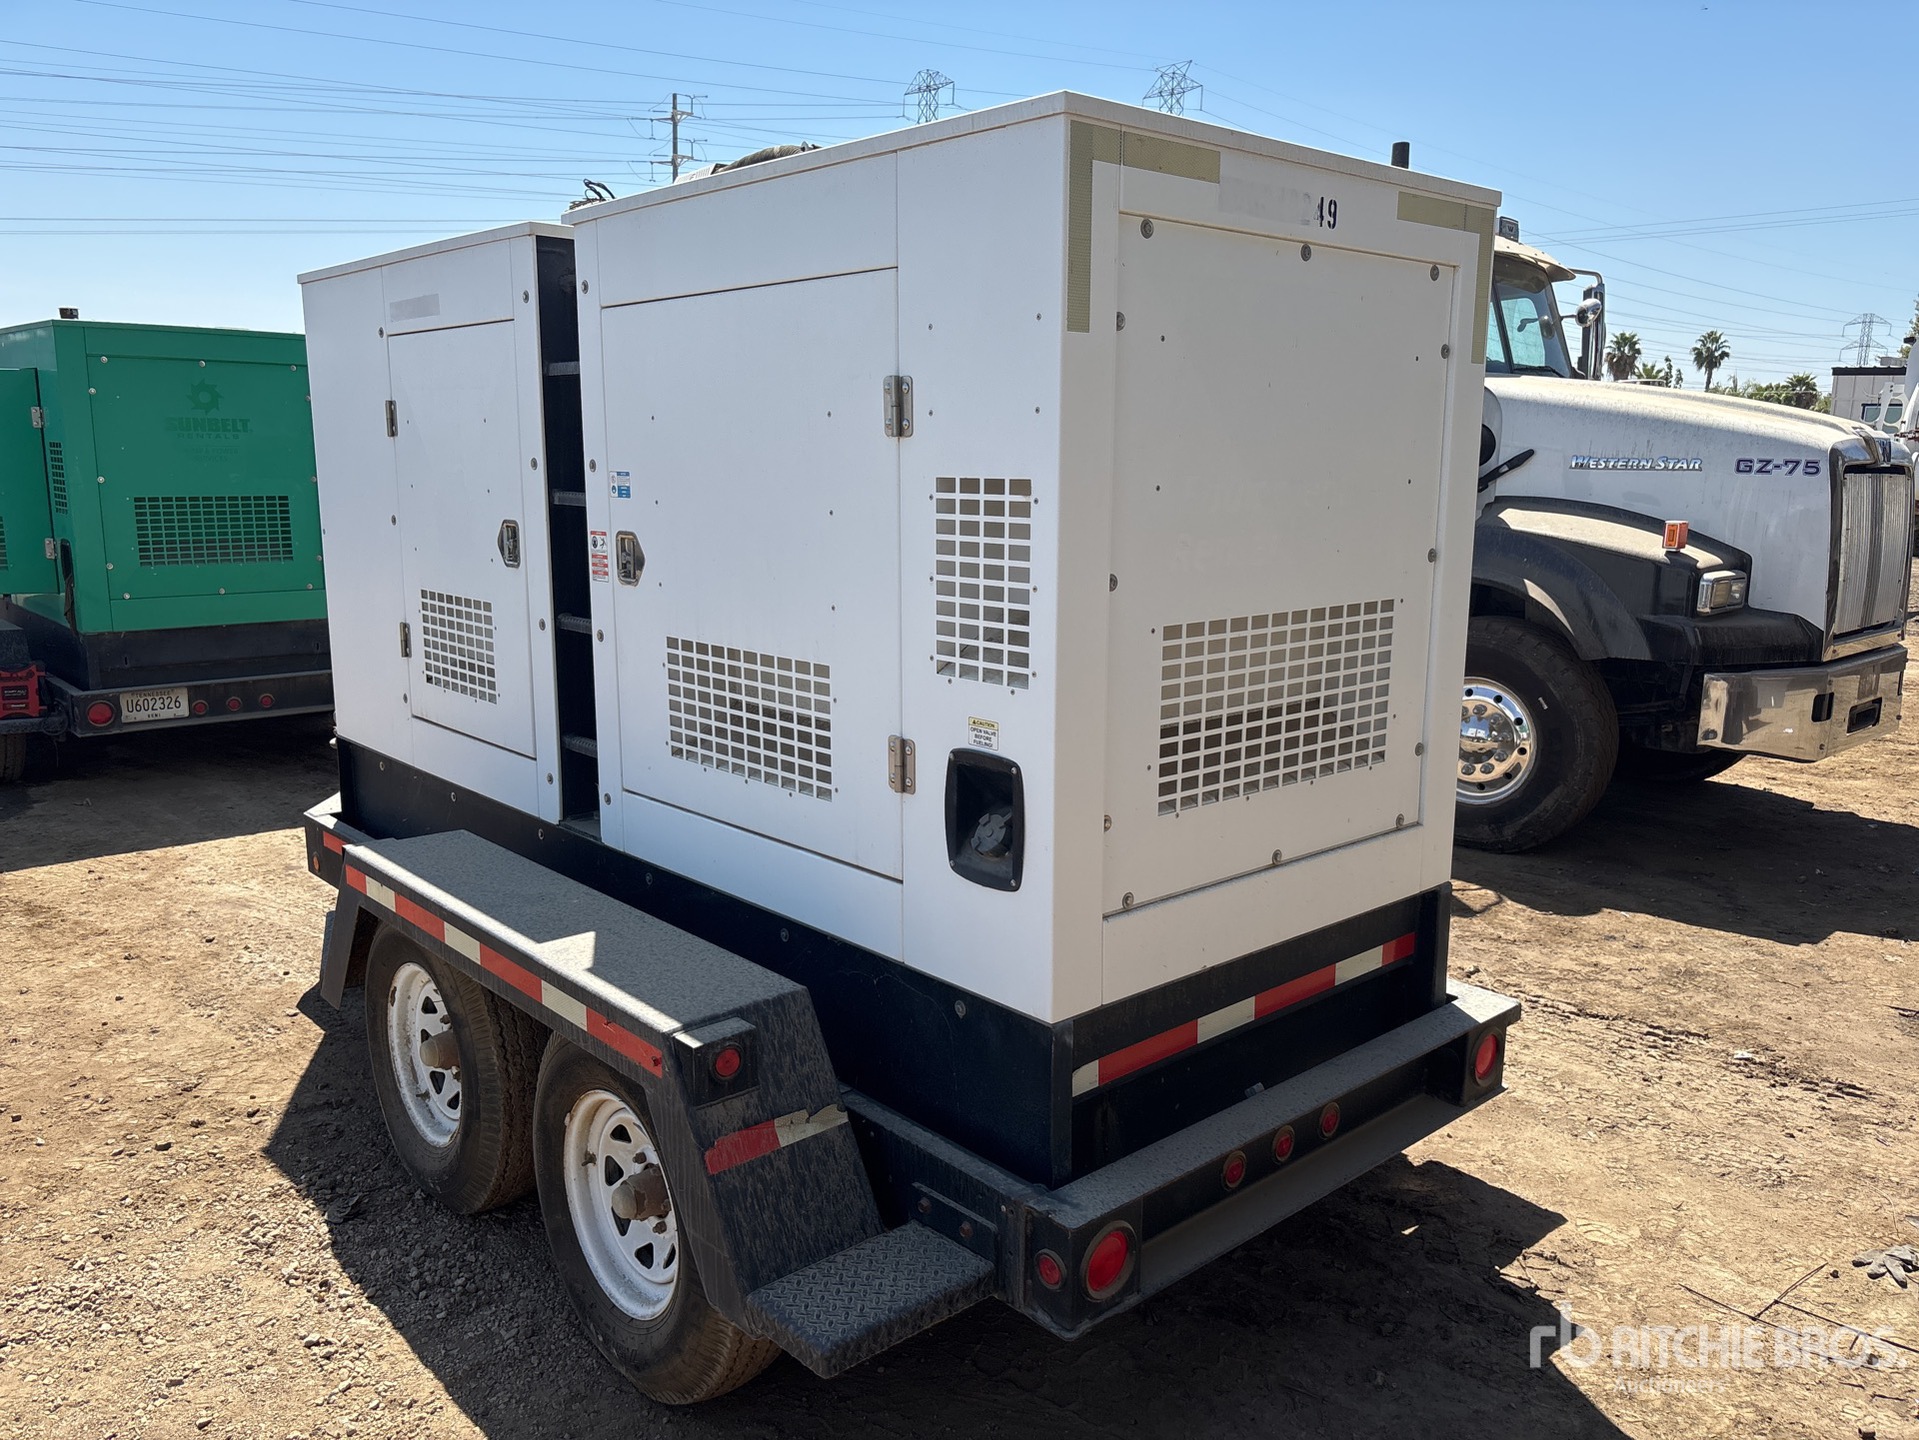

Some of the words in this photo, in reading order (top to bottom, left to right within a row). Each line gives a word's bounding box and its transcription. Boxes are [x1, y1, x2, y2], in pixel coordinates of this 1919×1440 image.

[165, 416, 250, 432] SUNBELT
[1570, 455, 1651, 470] WESTERN
[1654, 456, 1702, 471] STAR
[1735, 458, 1822, 476] GZ-75
[136, 690, 171, 698] TENNESSEE
[126, 696, 182, 713] U602326
[974, 733, 992, 742] BEFORE
